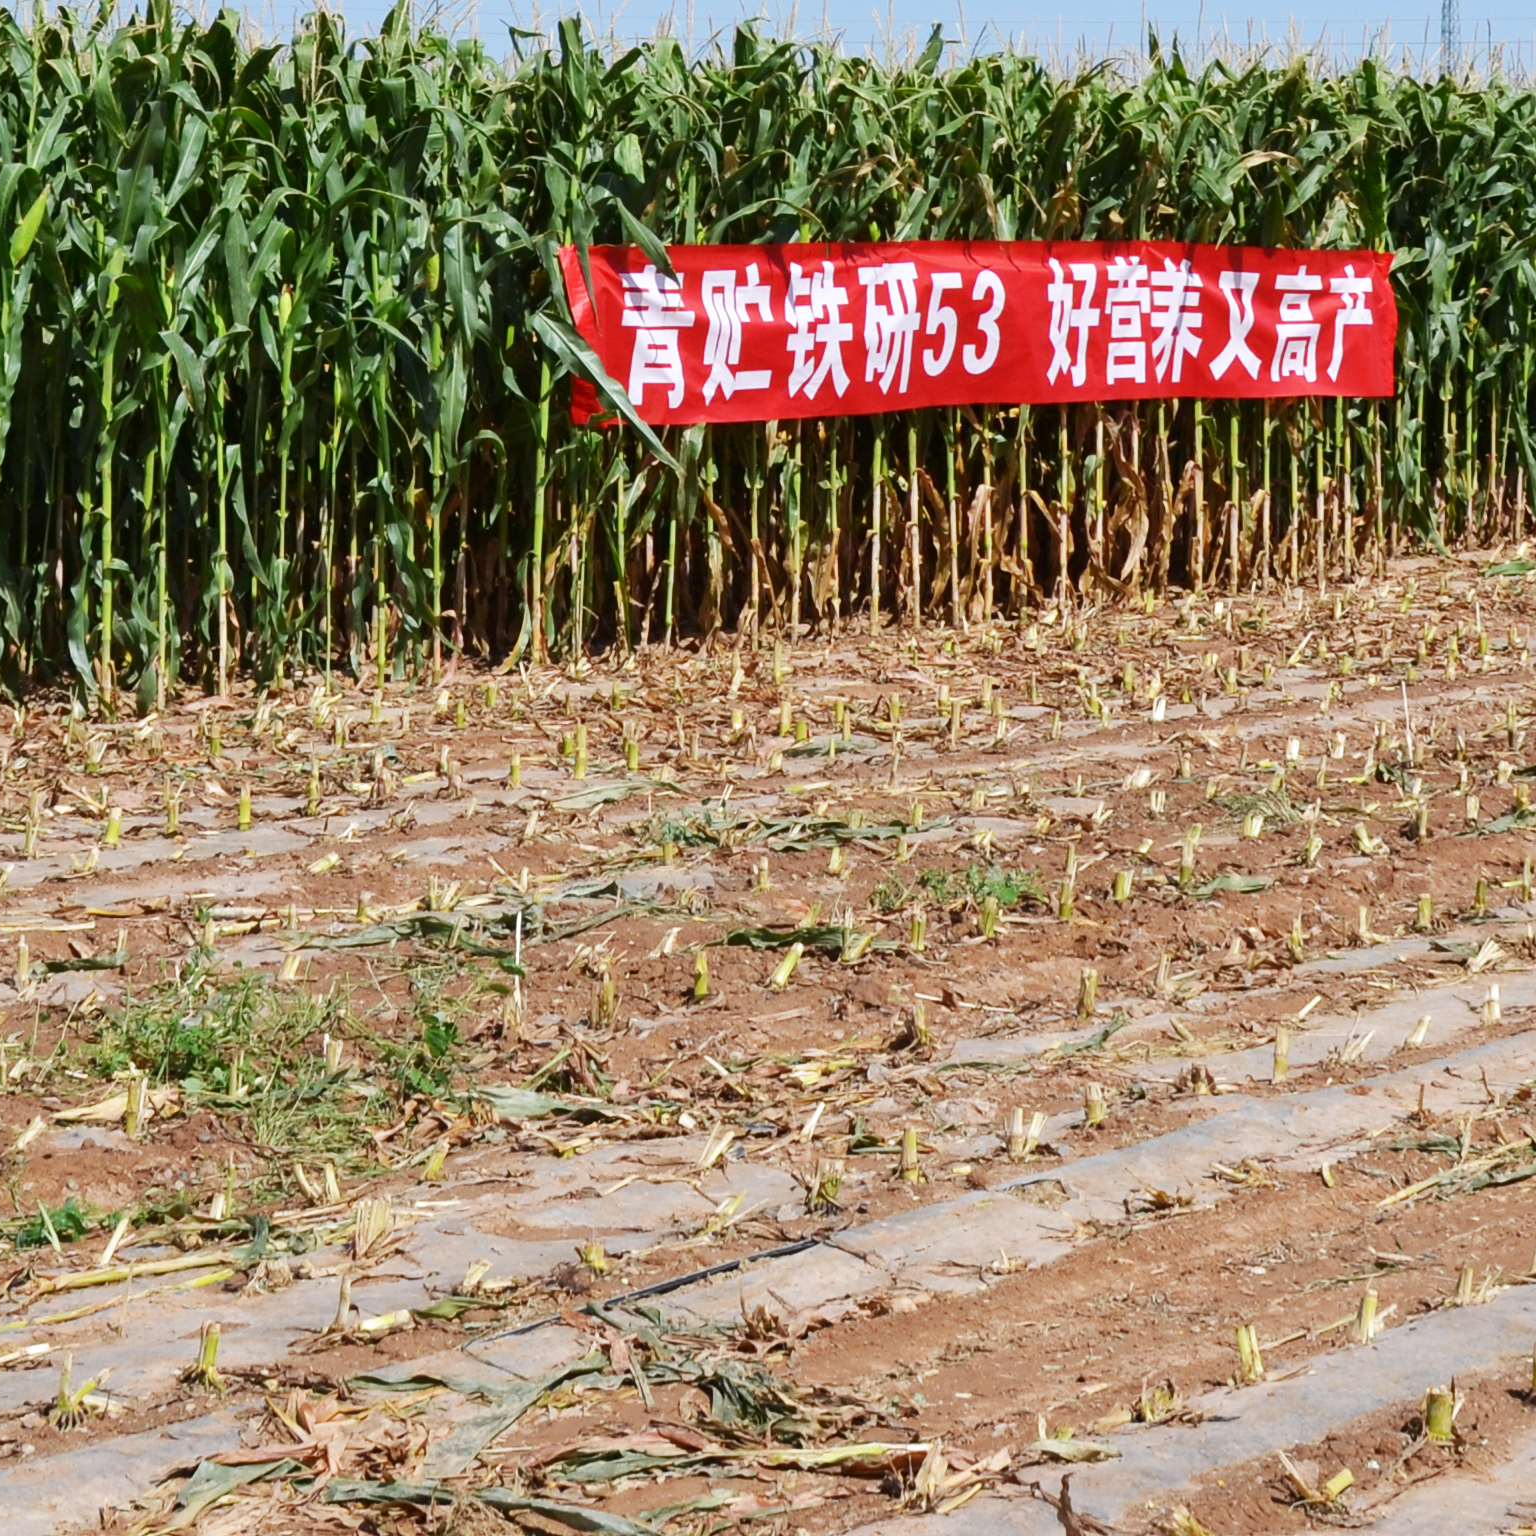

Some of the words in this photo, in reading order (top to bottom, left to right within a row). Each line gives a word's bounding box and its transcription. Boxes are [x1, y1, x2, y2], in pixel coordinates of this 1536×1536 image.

[620, 260, 1006, 409] 青贮铁研53
[1046, 256, 1374, 387] 好营养又高产
